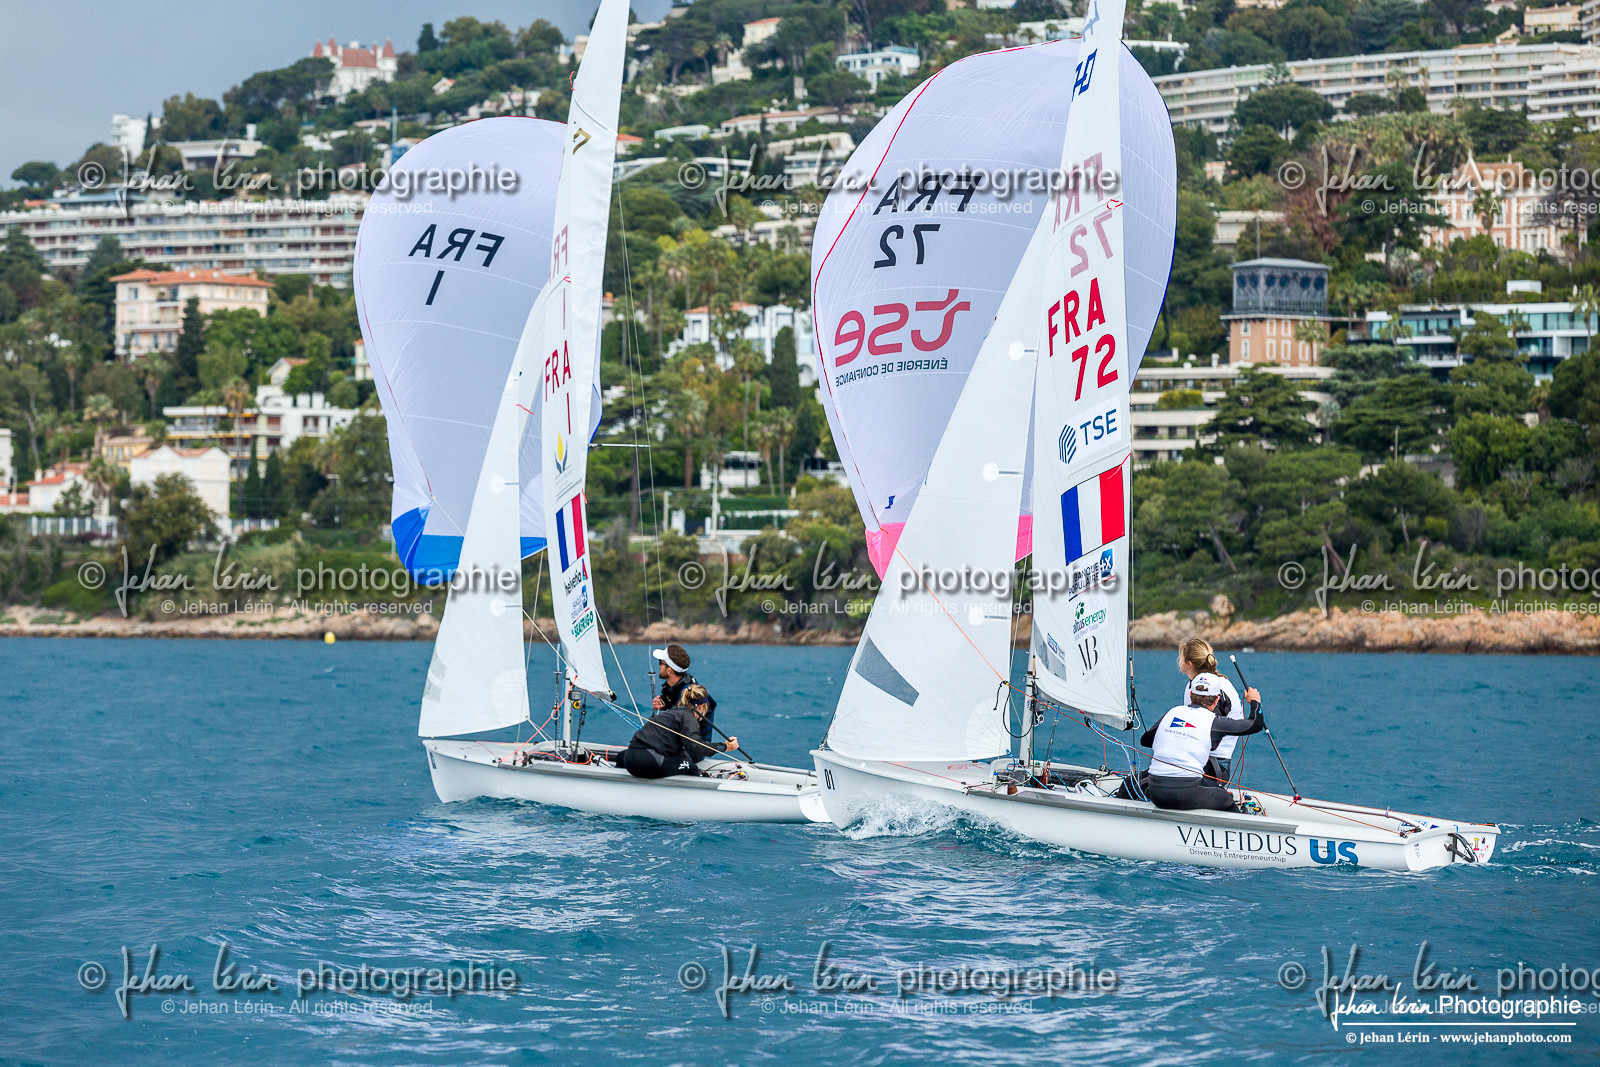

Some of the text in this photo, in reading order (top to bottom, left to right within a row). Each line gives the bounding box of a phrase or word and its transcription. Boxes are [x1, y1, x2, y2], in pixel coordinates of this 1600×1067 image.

[1047, 277, 1106, 358] FRA
[545, 339, 572, 402] FRA
[1071, 333, 1119, 402] 72
[1079, 408, 1118, 446] TSE
[1068, 571, 1100, 597] POPULAIRE
[1073, 562, 1099, 583] BANQUE
[824, 768, 836, 790] 01
[1177, 825, 1297, 856] VALFIDUS
[1189, 848, 1287, 864] Driven by Entrepreneurship
